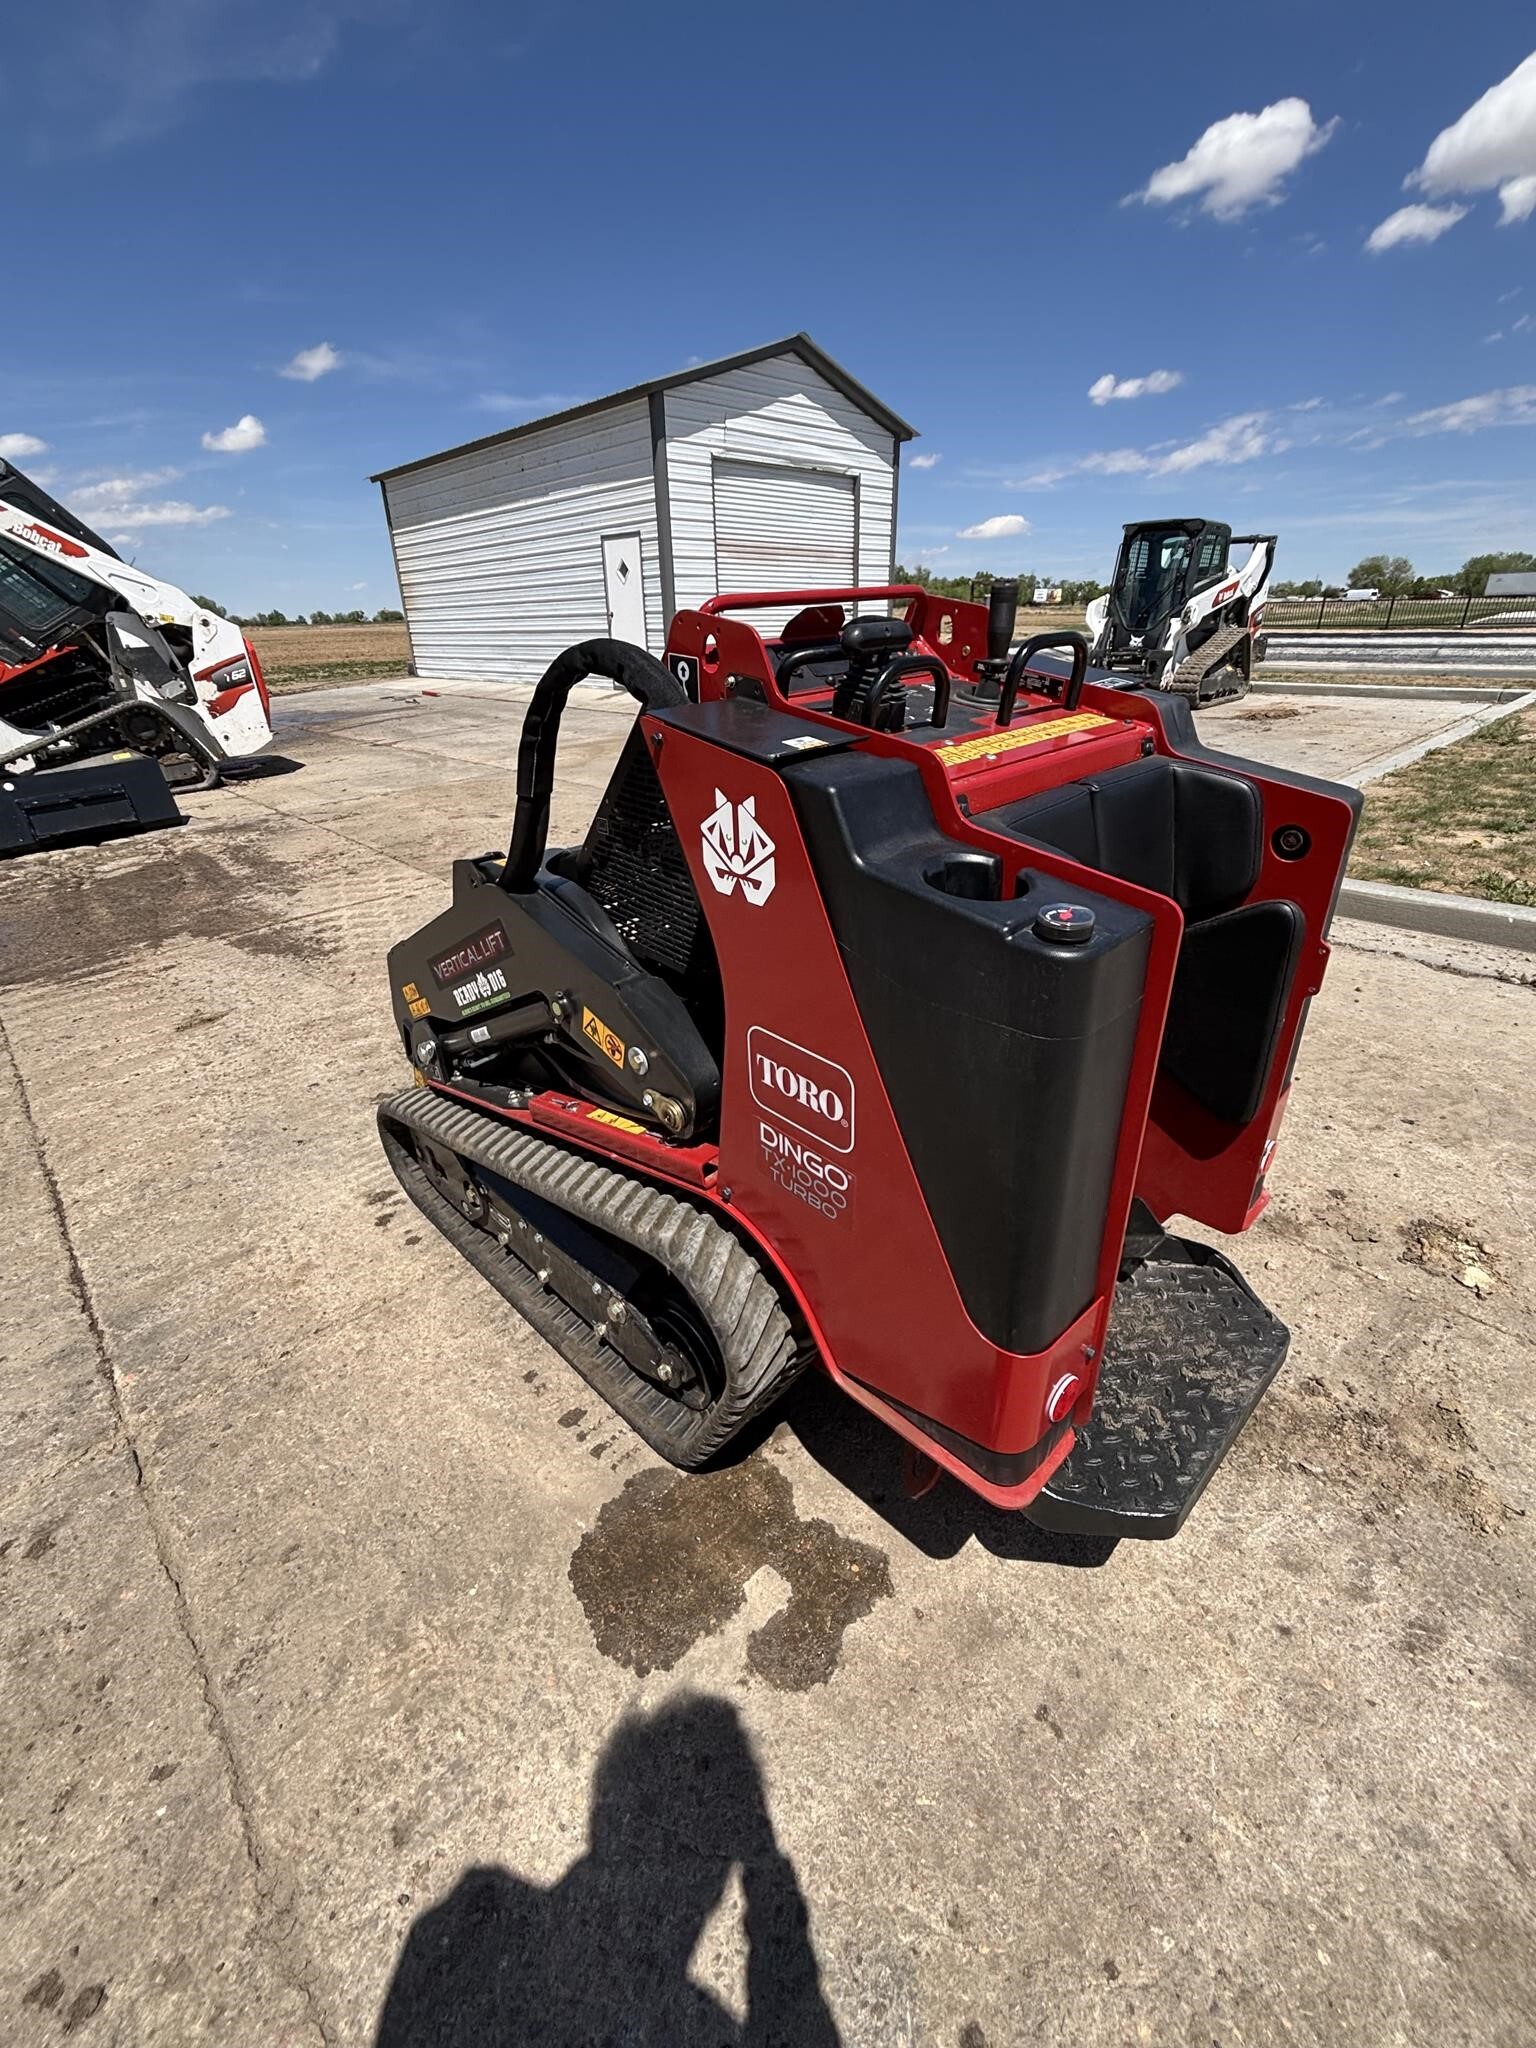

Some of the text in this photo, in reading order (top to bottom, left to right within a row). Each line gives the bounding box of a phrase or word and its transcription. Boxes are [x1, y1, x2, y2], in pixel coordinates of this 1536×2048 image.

[13, 522, 62, 553] Bobcat
[433, 930, 504, 979] VERTICAL LIFT
[452, 980, 480, 1007] READY
[487, 968, 507, 992] DIG
[760, 1121, 848, 1191] DINGO
[770, 1166, 837, 1220] TURBO
